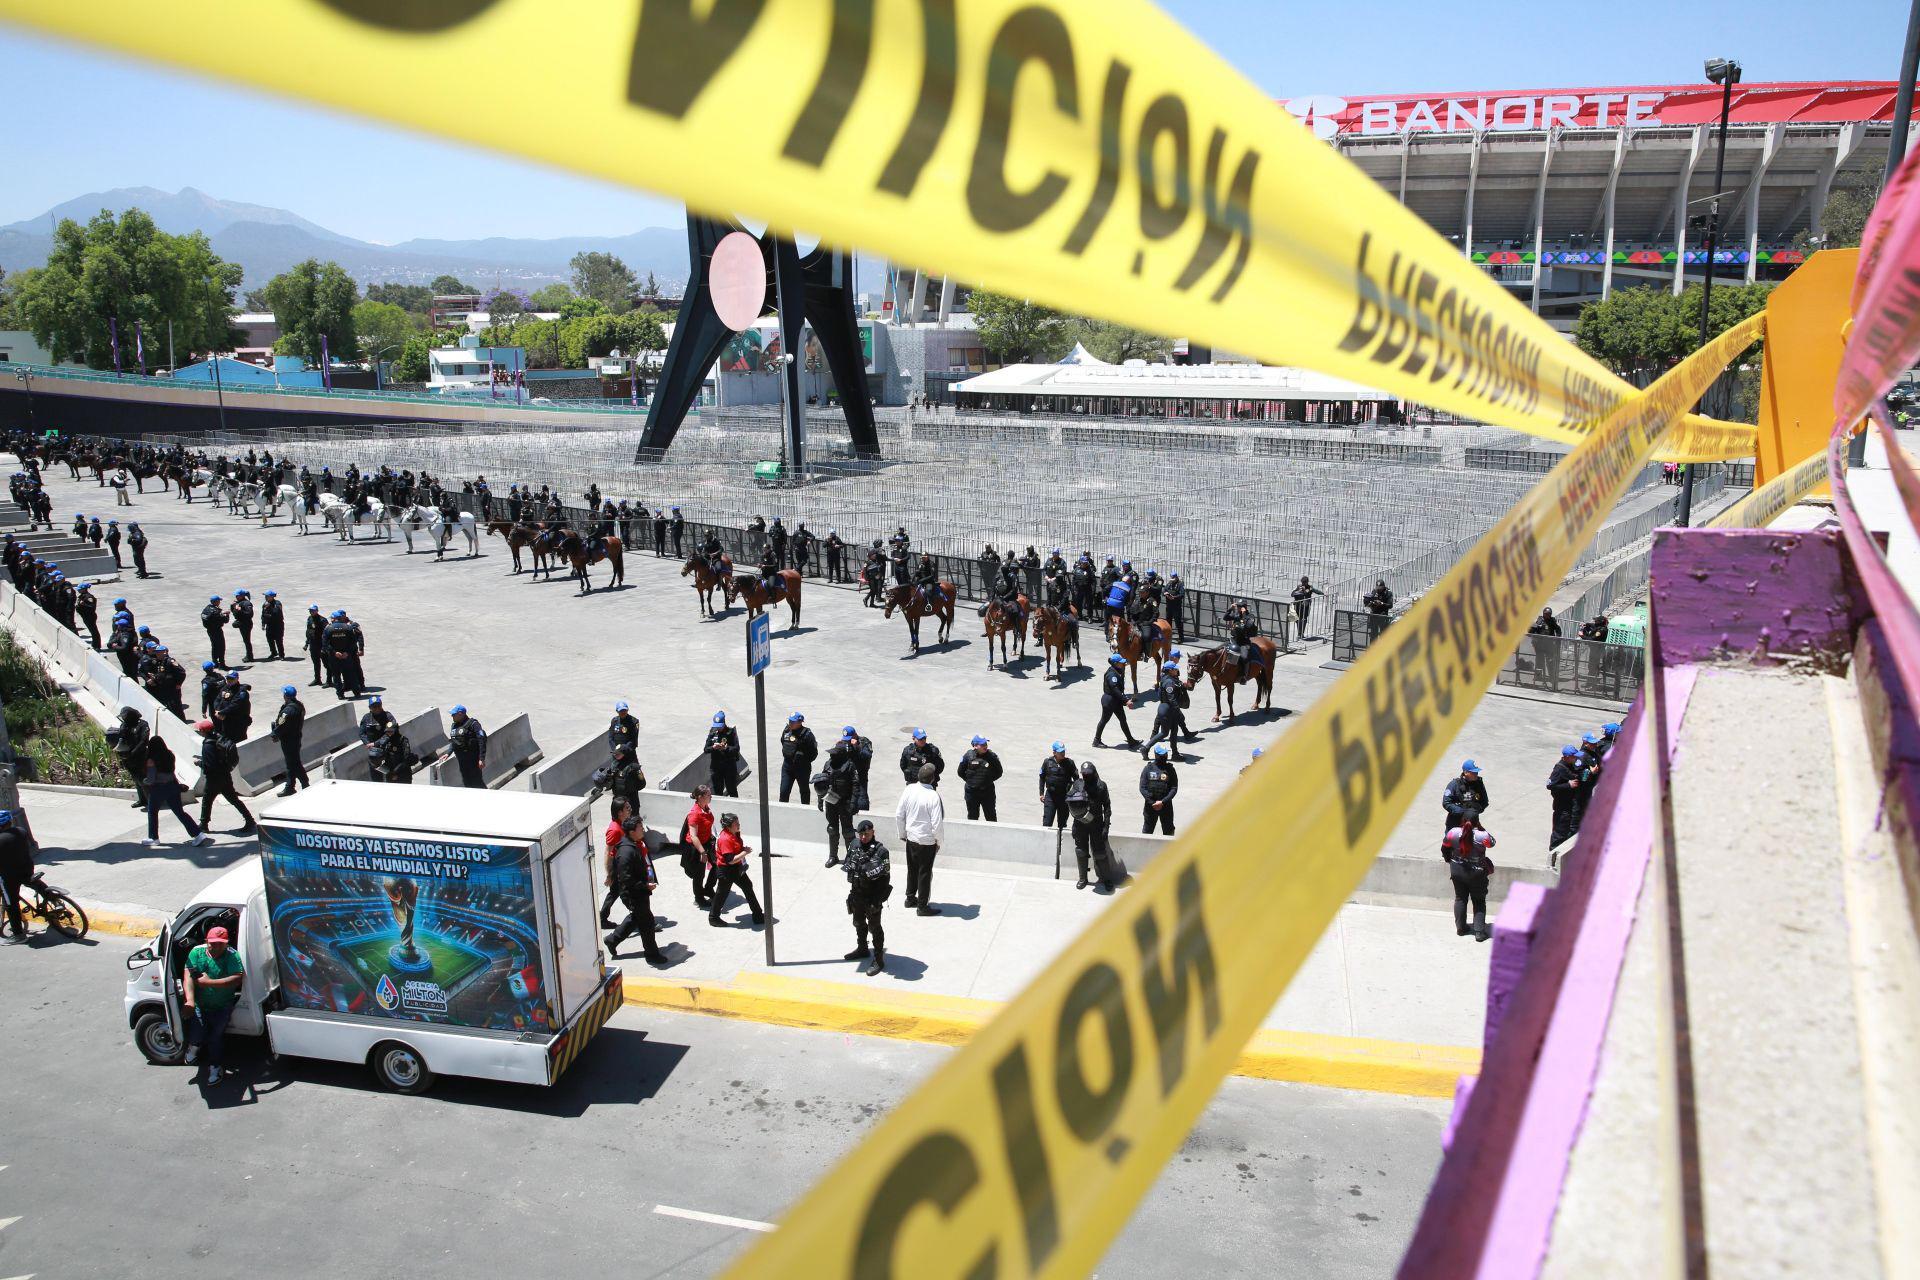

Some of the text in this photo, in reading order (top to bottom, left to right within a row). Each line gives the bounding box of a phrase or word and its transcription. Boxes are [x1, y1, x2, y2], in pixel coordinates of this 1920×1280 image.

[1361, 92, 1666, 135] BANORTE
[295, 833, 490, 863] NOSOTROS YA ESTAMOS LISTOS
[320, 853, 468, 879] PARA EL MUNDIAL Y TU?
[401, 986, 446, 1003] MILTON
[405, 981, 440, 990] AGENCIA
[406, 1000, 444, 1009] PUBLICIDAD
